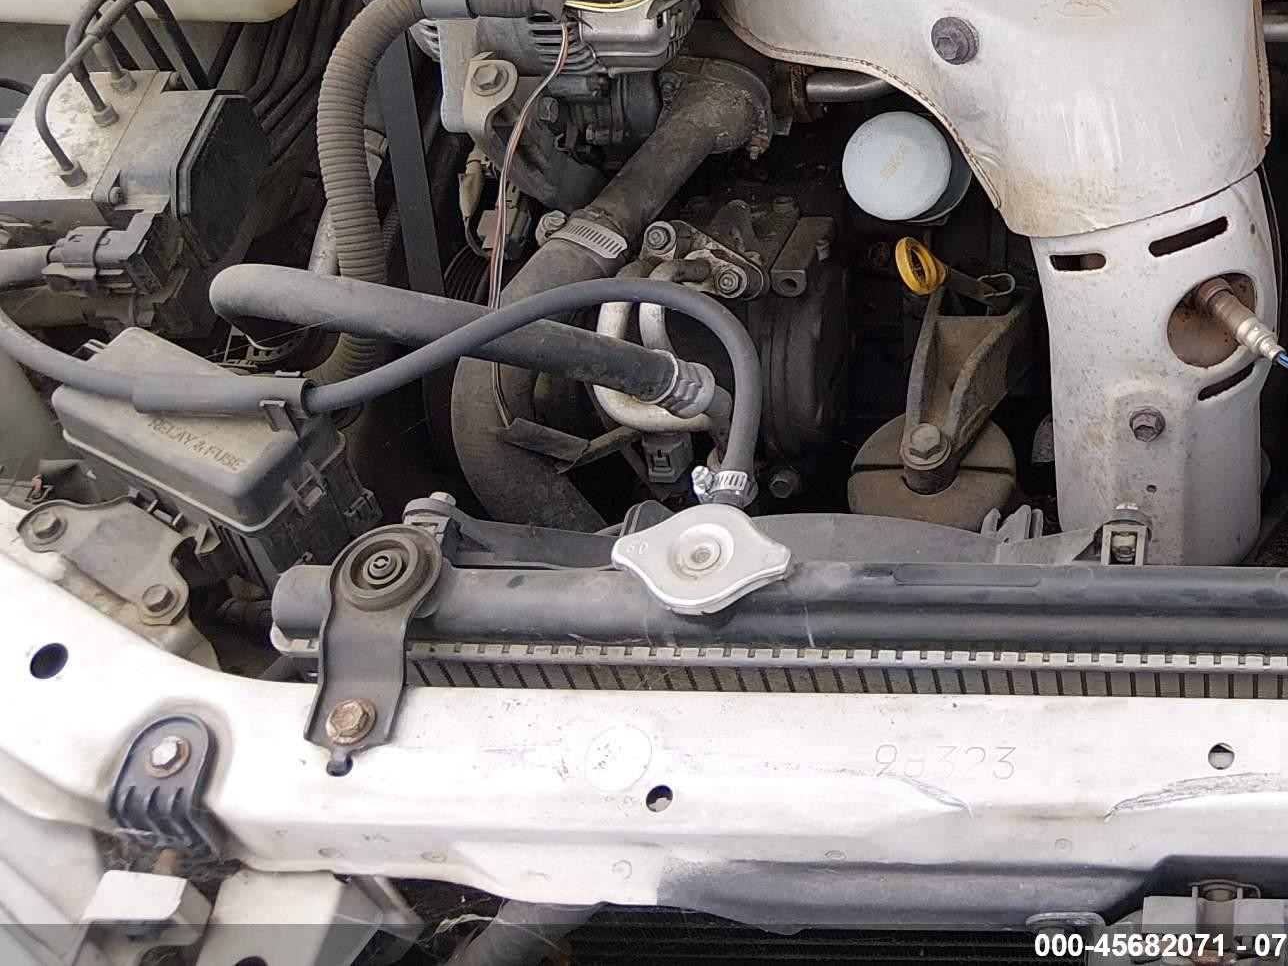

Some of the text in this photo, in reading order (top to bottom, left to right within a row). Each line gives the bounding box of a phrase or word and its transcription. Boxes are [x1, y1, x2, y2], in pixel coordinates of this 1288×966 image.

[147, 417, 244, 472] RELAY & FUSE
